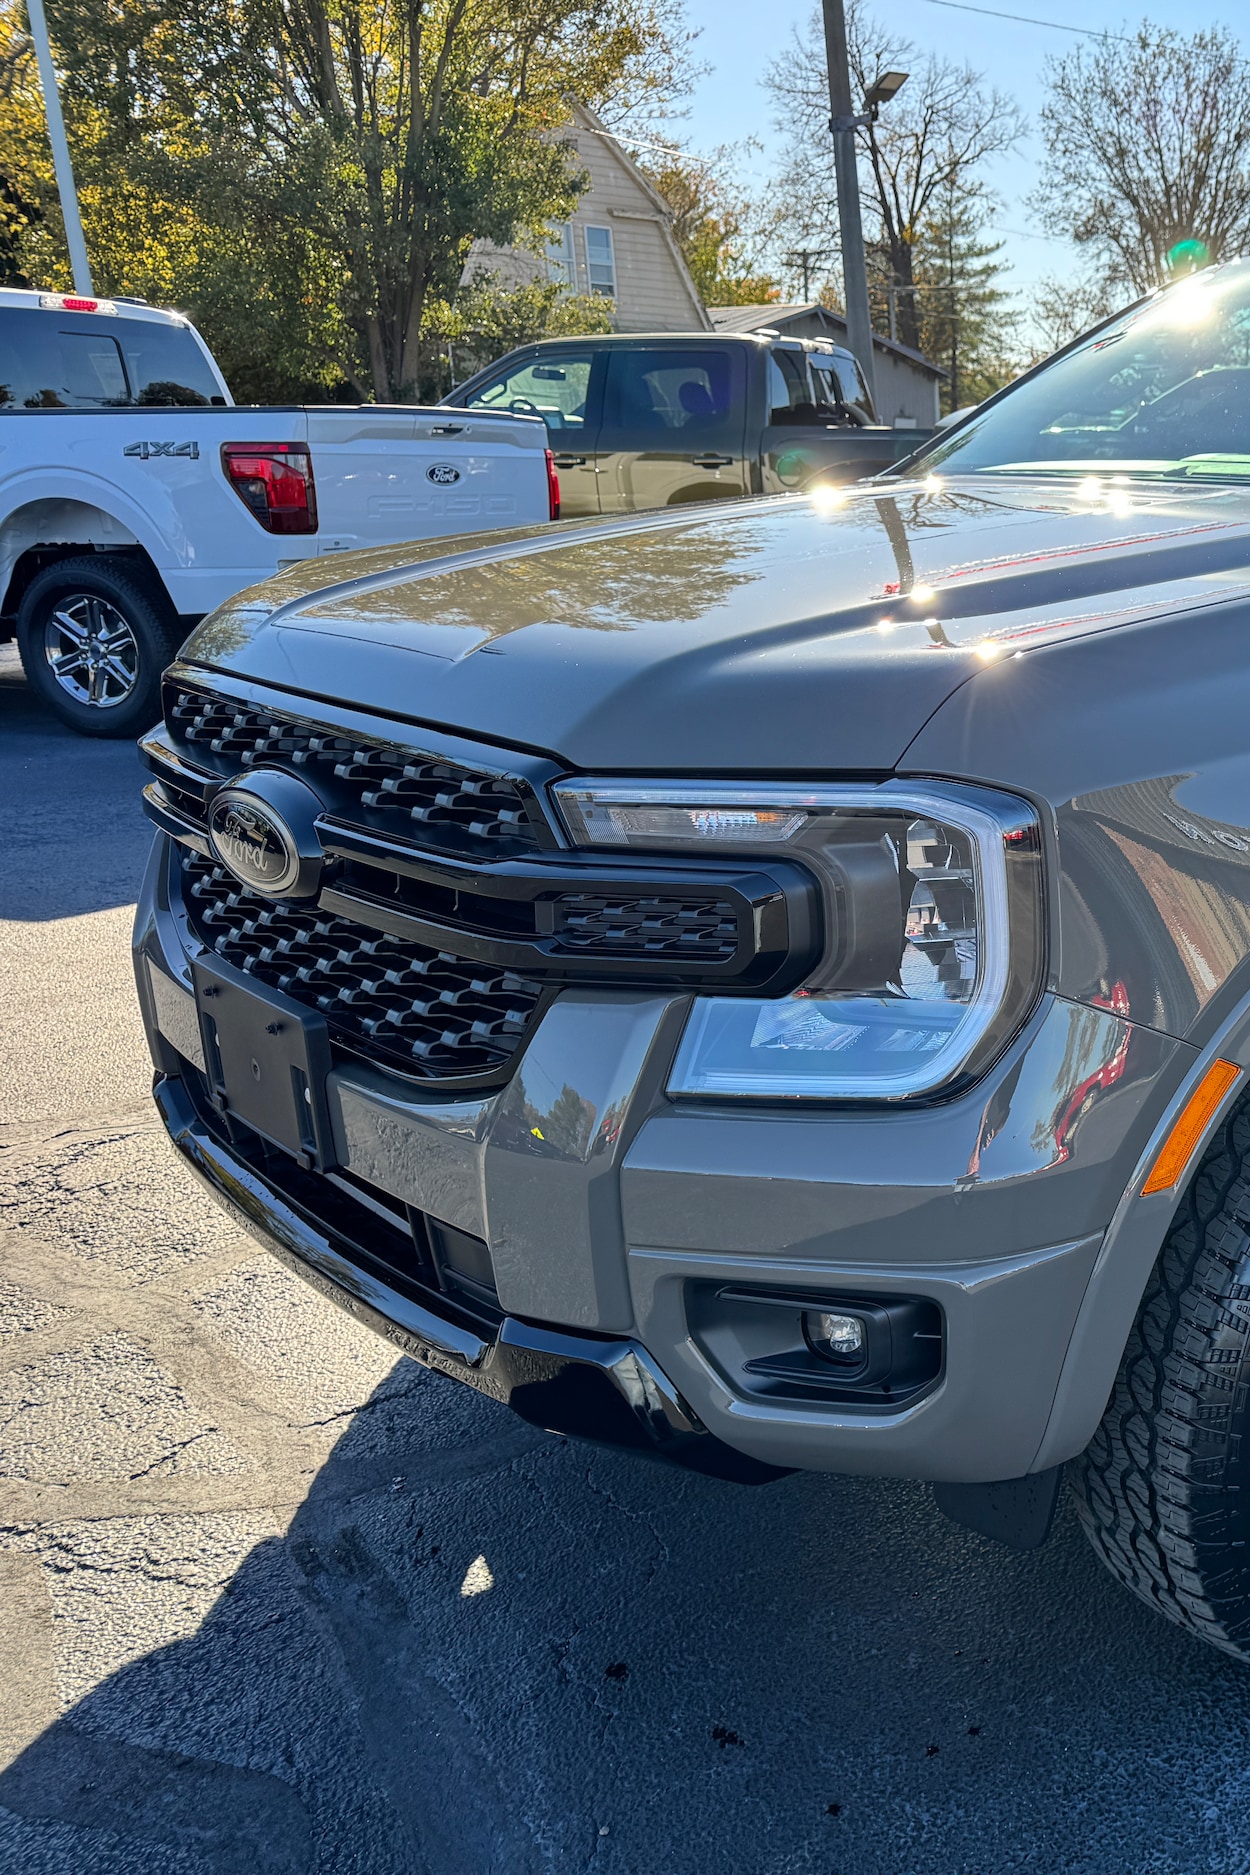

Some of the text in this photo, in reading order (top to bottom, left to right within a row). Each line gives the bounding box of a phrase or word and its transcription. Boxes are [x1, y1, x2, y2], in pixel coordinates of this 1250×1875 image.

[432, 467, 461, 483] Ford
[366, 493, 517, 519] F-150
[220, 811, 268, 872] Ford
